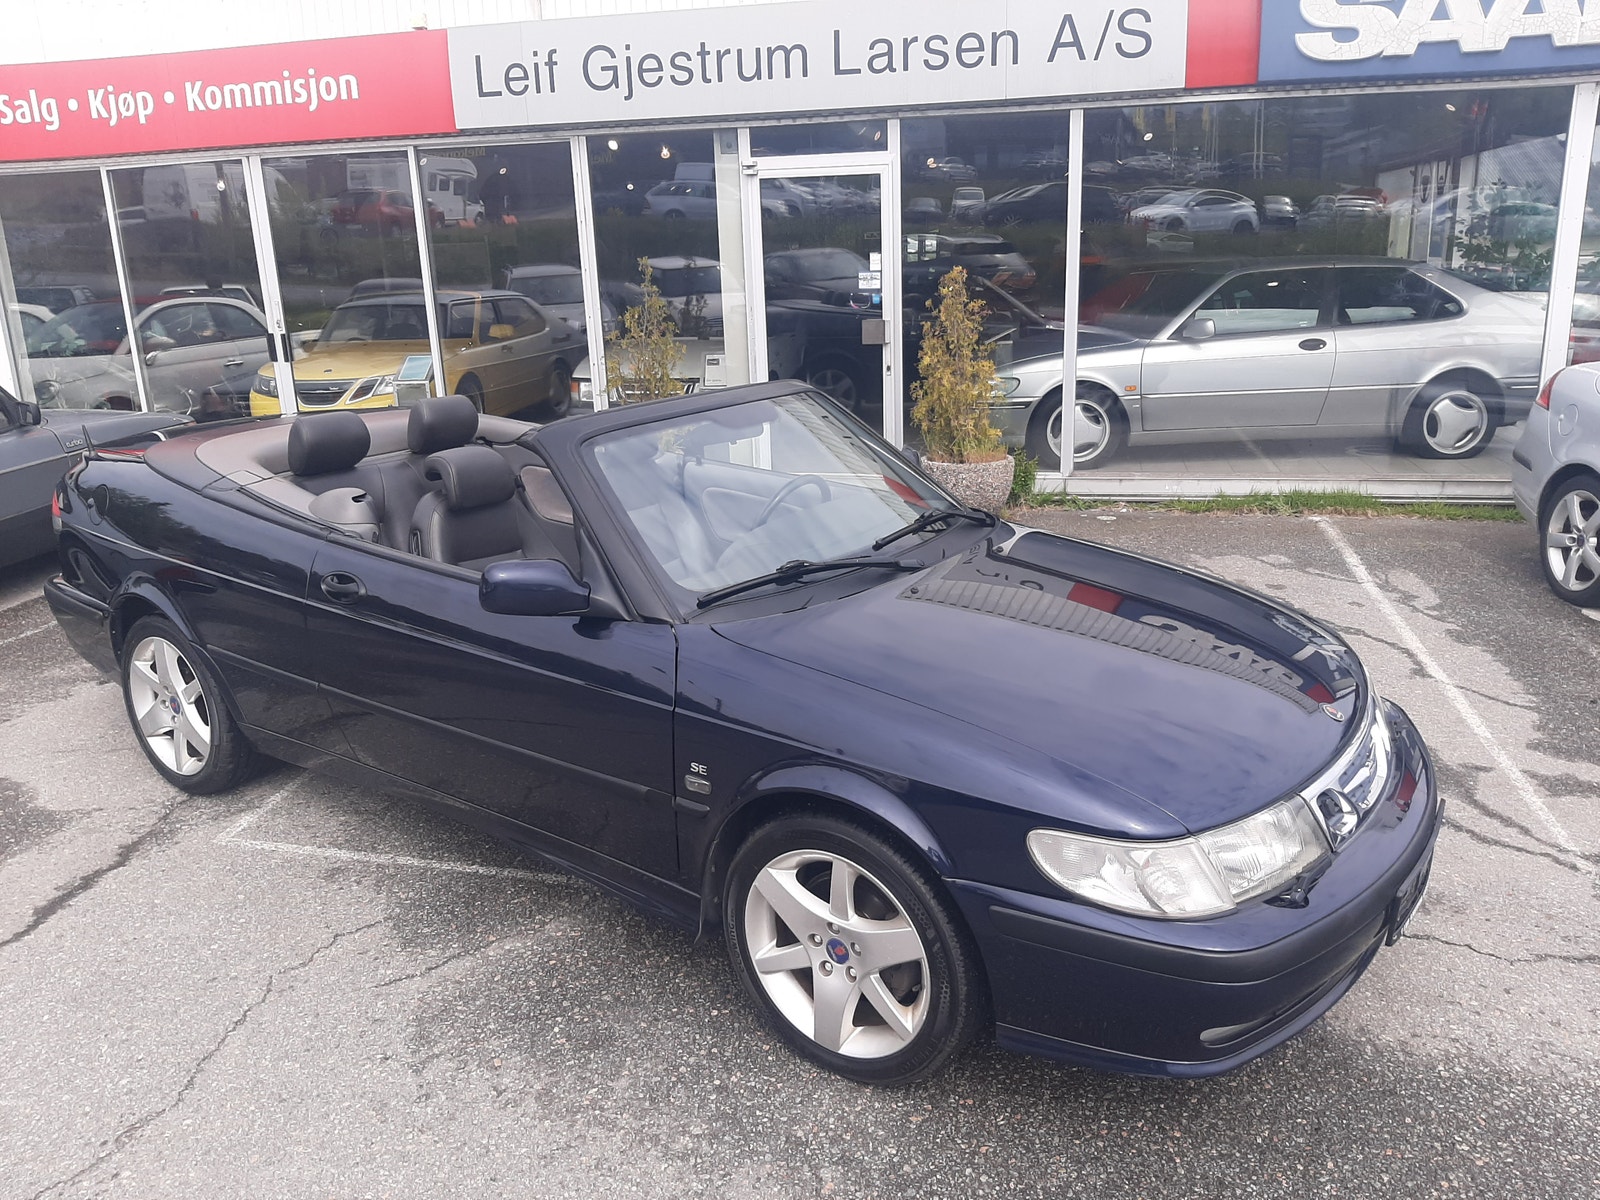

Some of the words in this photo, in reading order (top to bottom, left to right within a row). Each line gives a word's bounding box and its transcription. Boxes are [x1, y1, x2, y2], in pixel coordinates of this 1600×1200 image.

[474, 48, 558, 98] Leif
[582, 41, 808, 101] Gjestrum
[833, 29, 1019, 76] Larsen
[1047, 8, 1153, 63] A/S
[0, 89, 60, 131] Salg
[87, 85, 154, 127] Kjøp
[184, 68, 359, 112] Kommisjon
[66, 438, 83, 448] turbo
[690, 762, 708, 776] SE
